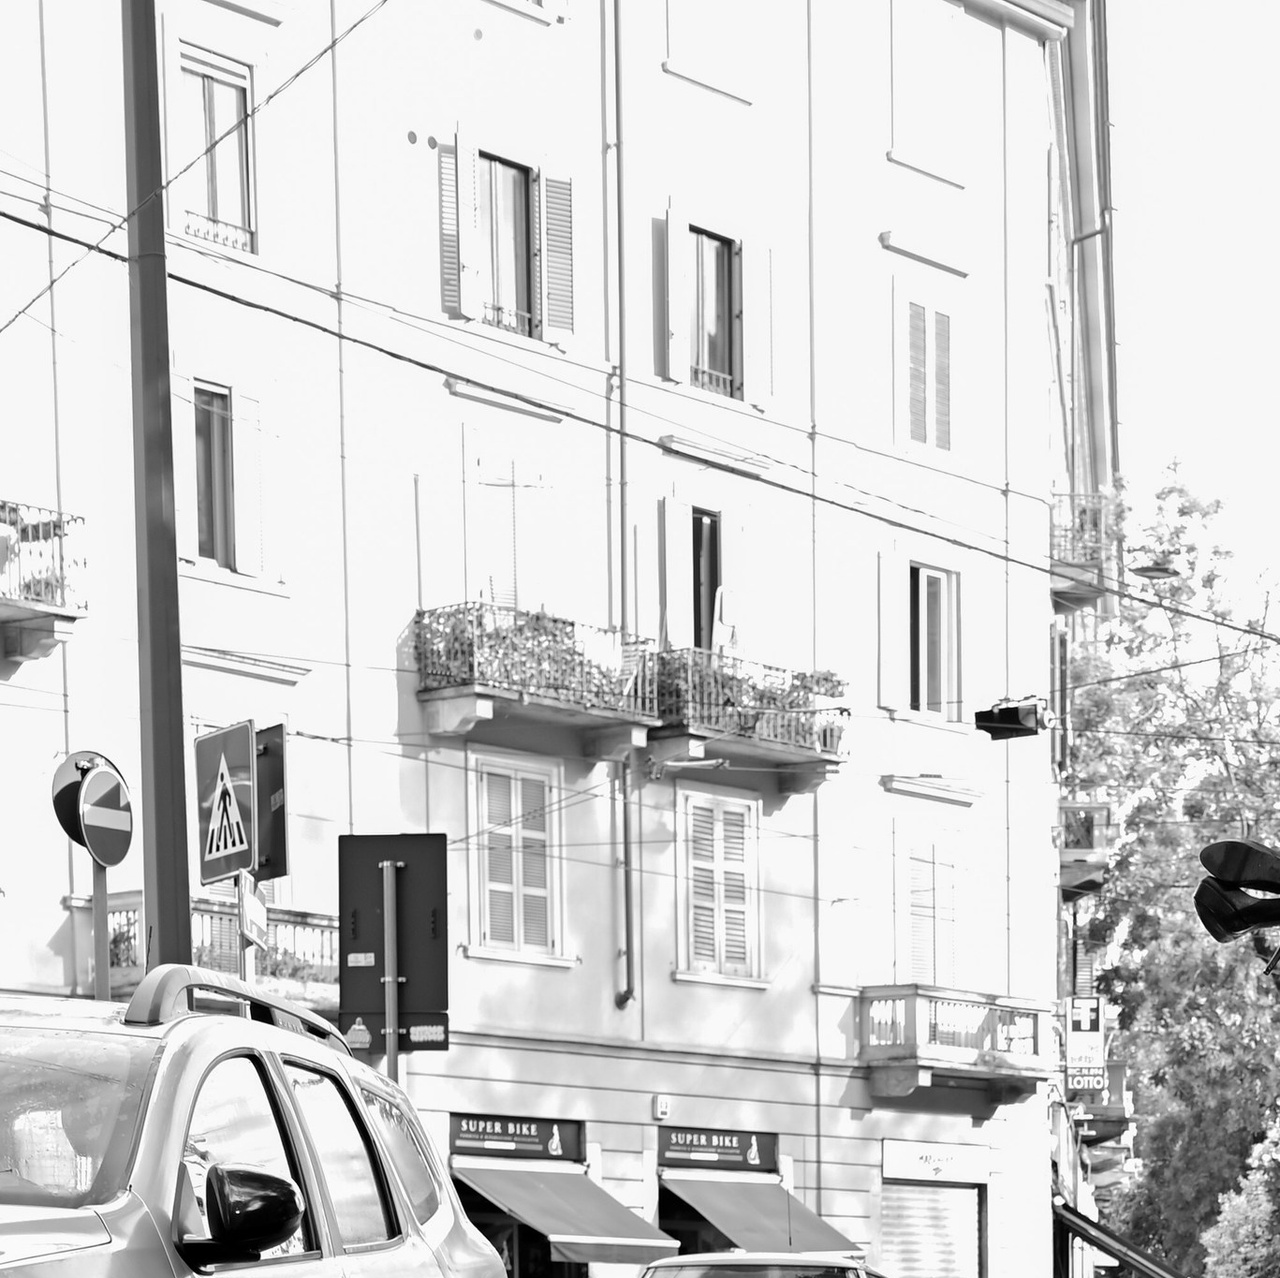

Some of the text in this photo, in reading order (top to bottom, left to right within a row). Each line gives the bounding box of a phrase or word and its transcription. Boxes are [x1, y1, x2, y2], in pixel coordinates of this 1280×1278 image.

[1068, 1076, 1104, 1090] LOTTO
[460, 1118, 538, 1137] SUPER BIKE
[670, 1132, 740, 1148] SUPER BIKE
